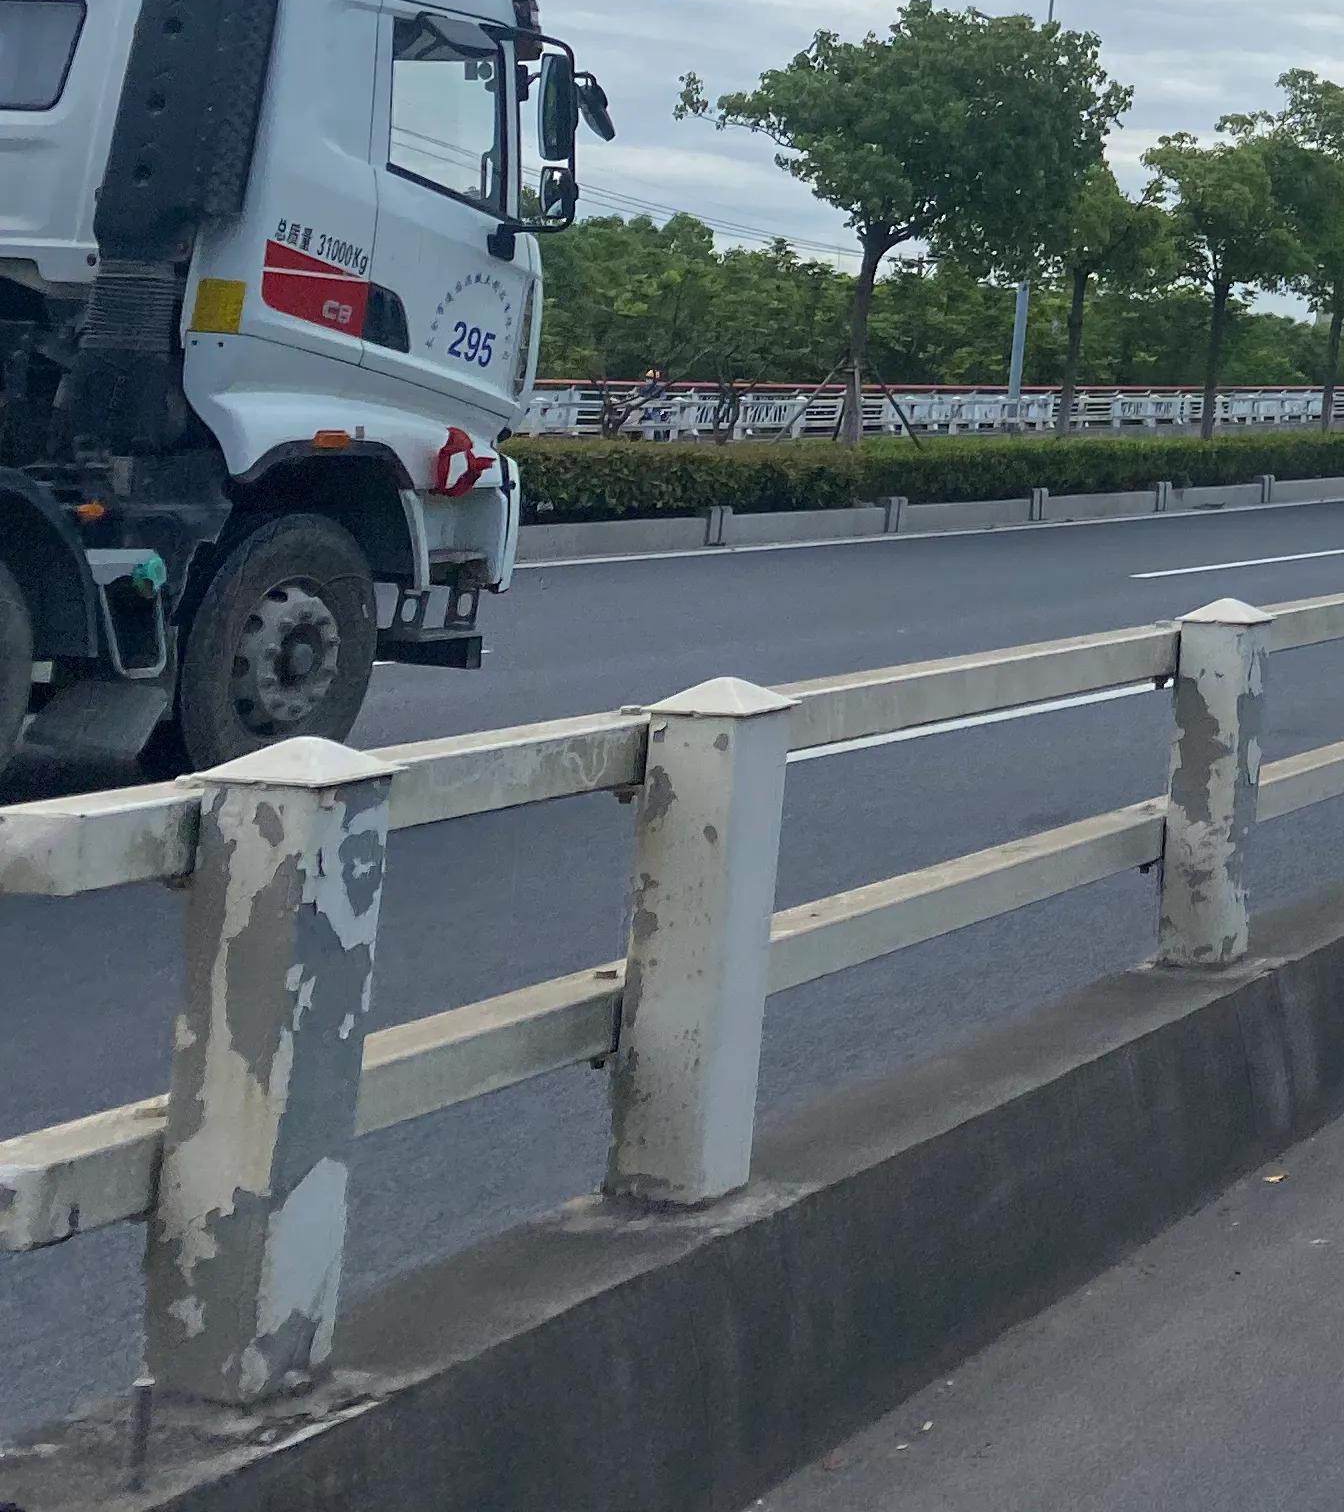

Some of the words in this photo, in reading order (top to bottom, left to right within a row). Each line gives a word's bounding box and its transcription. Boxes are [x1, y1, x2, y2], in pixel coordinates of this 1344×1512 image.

[275, 218, 313, 251] 总质量
[317, 234, 369, 275] 31000Kg
[448, 321, 496, 367] 295
